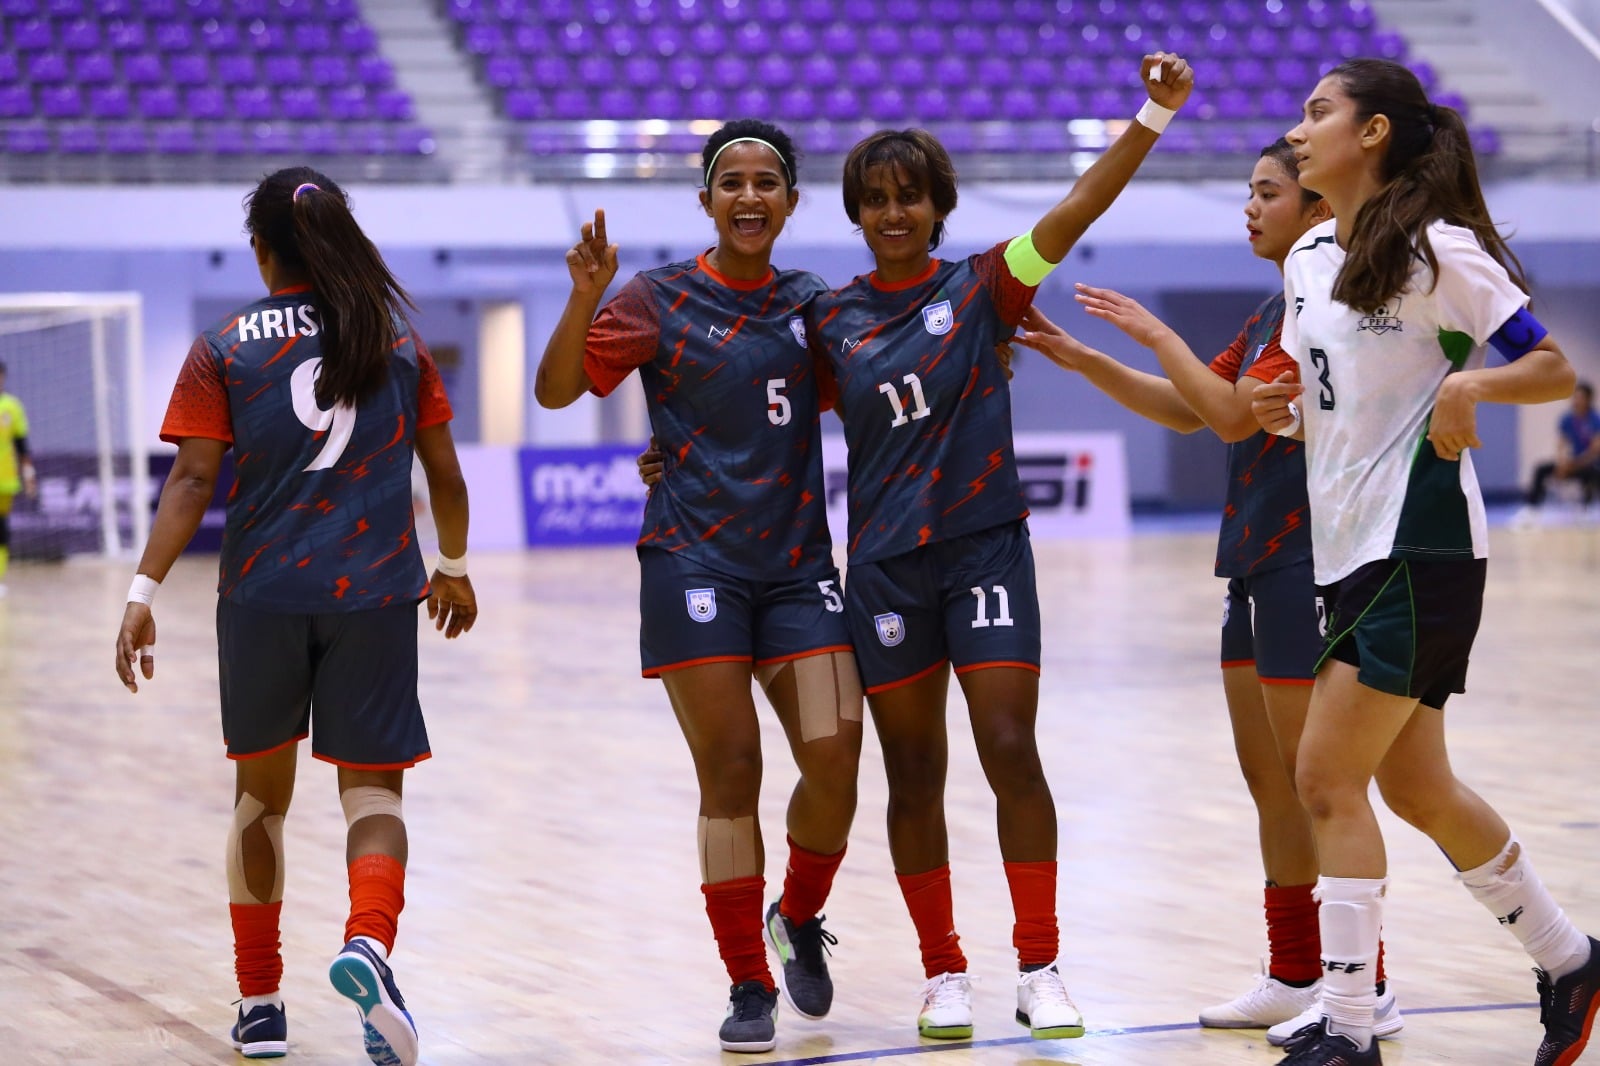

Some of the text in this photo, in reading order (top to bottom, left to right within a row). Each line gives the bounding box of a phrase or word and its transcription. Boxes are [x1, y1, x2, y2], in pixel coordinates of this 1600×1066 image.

[238, 303, 325, 343] KRIS
[1369, 318, 1391, 326] PFF
[766, 377, 792, 427] 5
[878, 372, 931, 429] 11
[1310, 347, 1336, 411] 3
[290, 356, 357, 473] 9
[816, 579, 844, 613] 5
[970, 584, 1014, 629] 11
